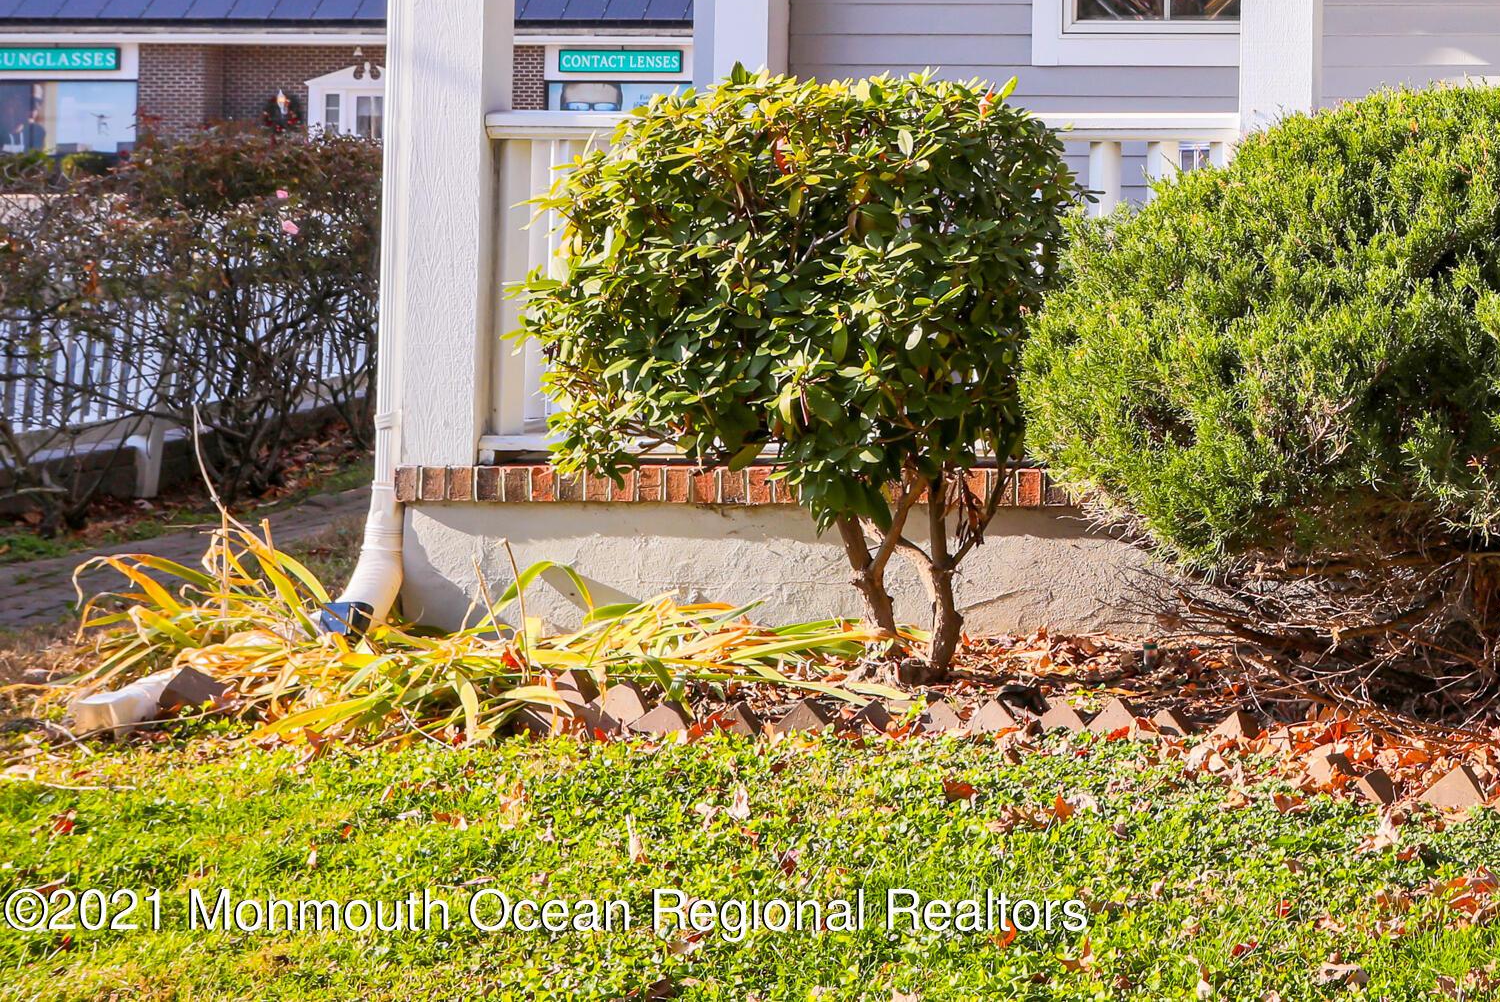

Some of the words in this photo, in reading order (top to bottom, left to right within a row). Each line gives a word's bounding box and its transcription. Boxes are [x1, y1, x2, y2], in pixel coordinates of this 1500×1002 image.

[0, 52, 116, 67] UNGLASSES
[562, 54, 626, 68] CONTACT
[629, 55, 679, 68] LENSES
